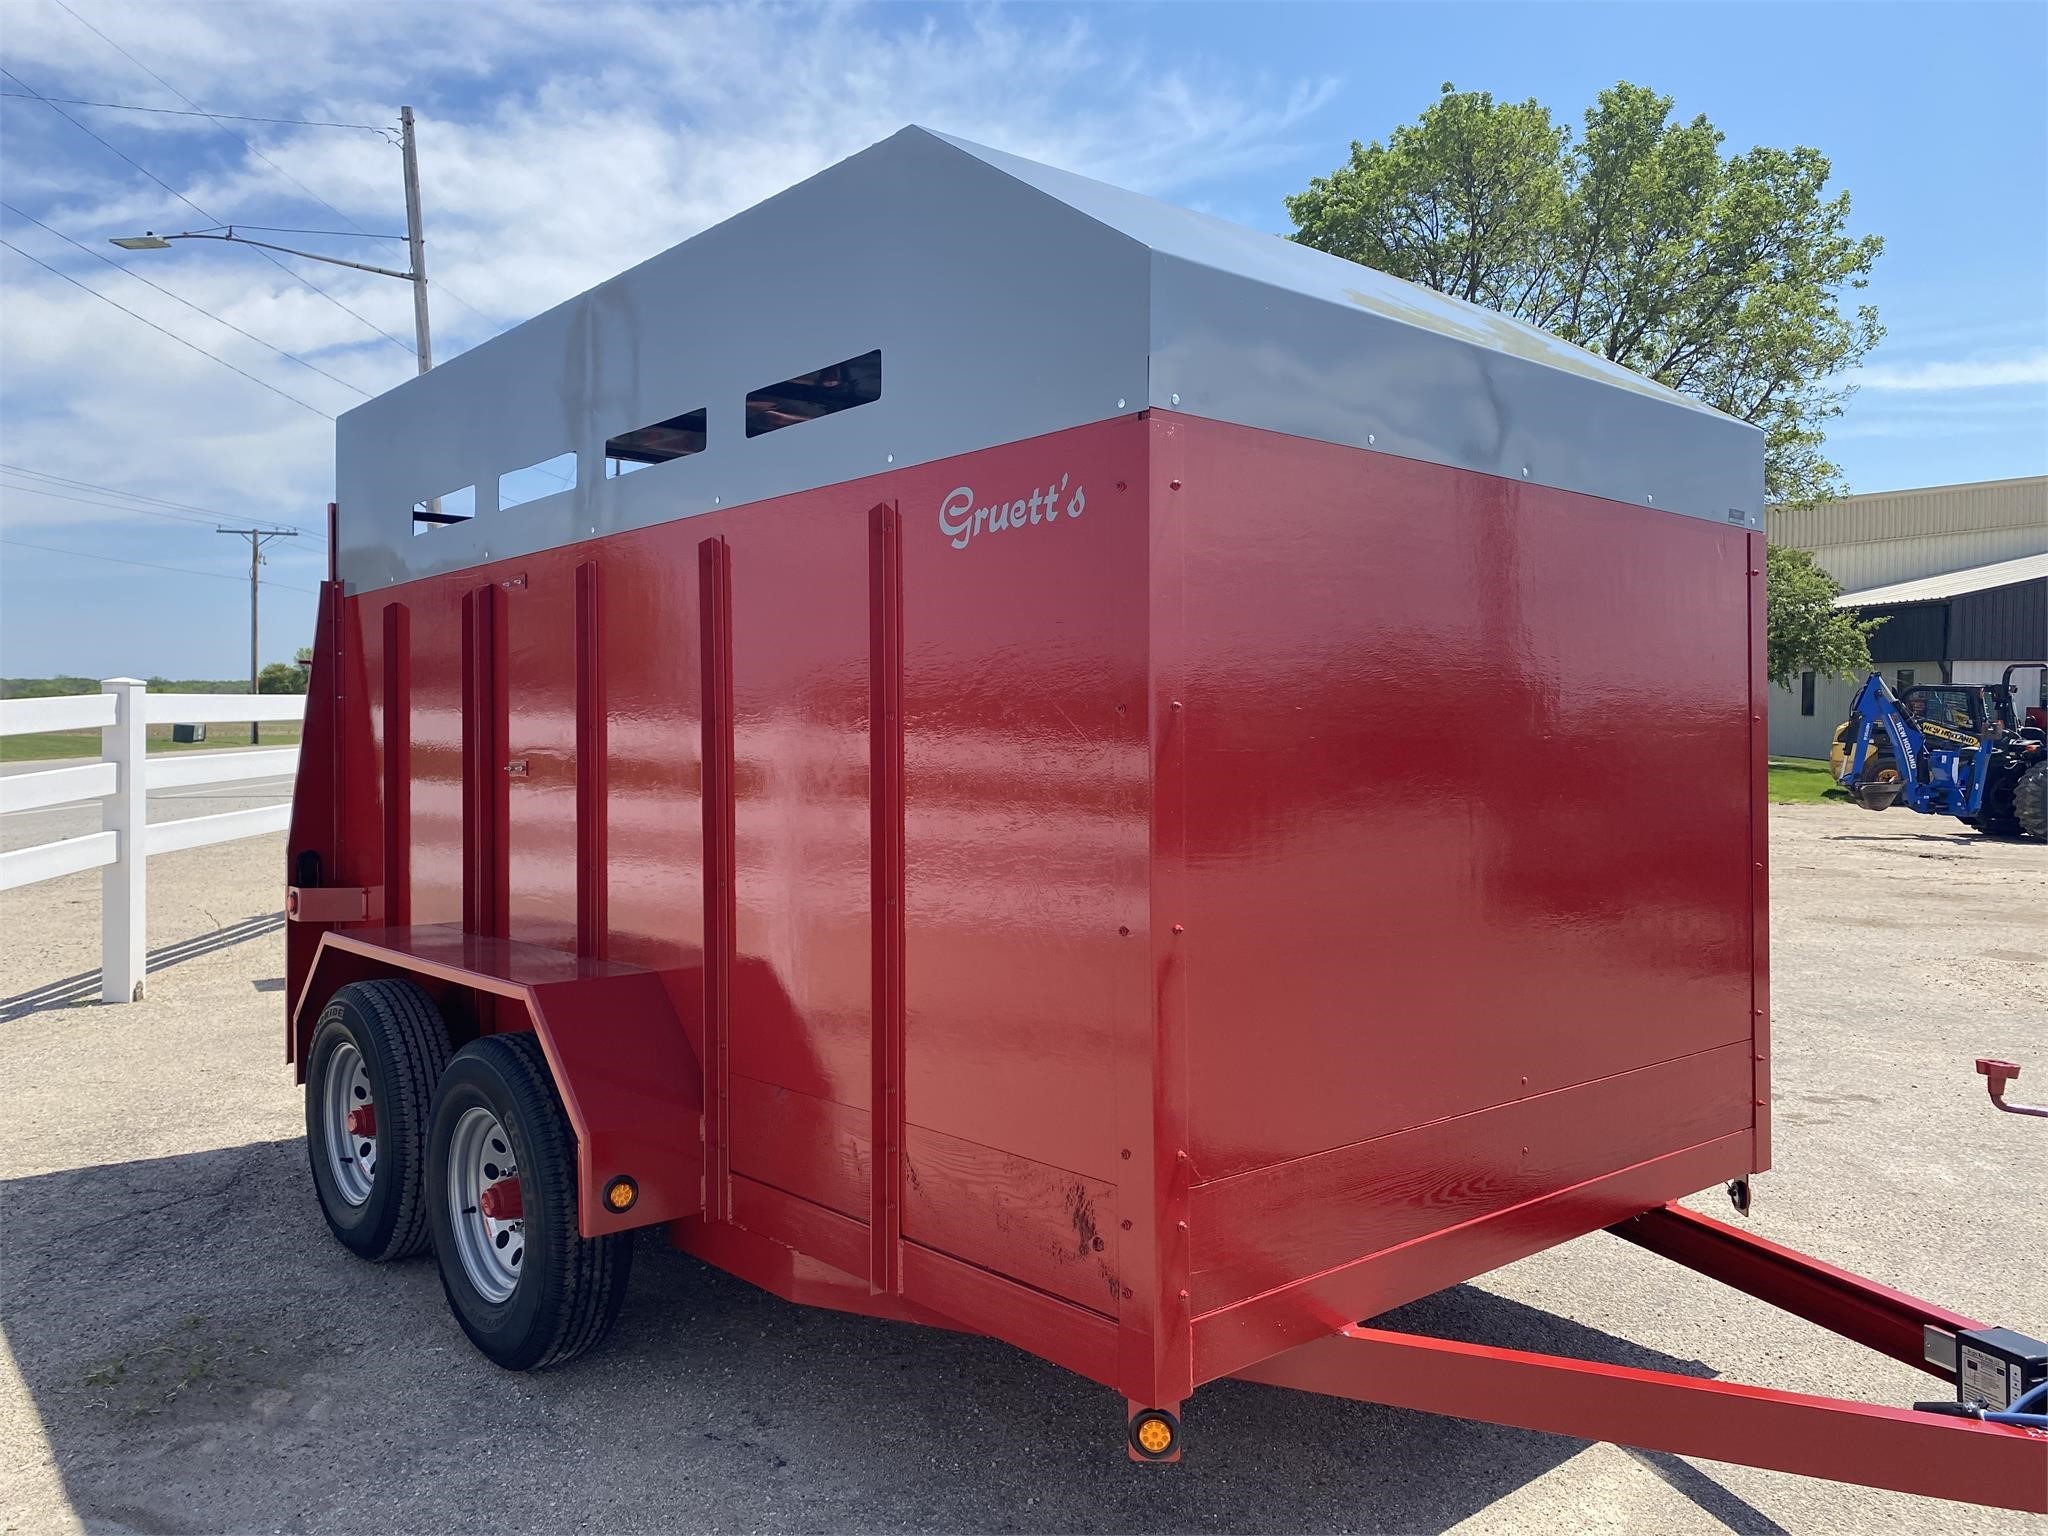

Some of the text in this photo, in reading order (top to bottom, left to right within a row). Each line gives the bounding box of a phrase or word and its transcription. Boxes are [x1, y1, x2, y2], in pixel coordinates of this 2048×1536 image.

[938, 472, 1086, 549] Gruett's
[1896, 722, 1917, 769] NEW HOLLAND
